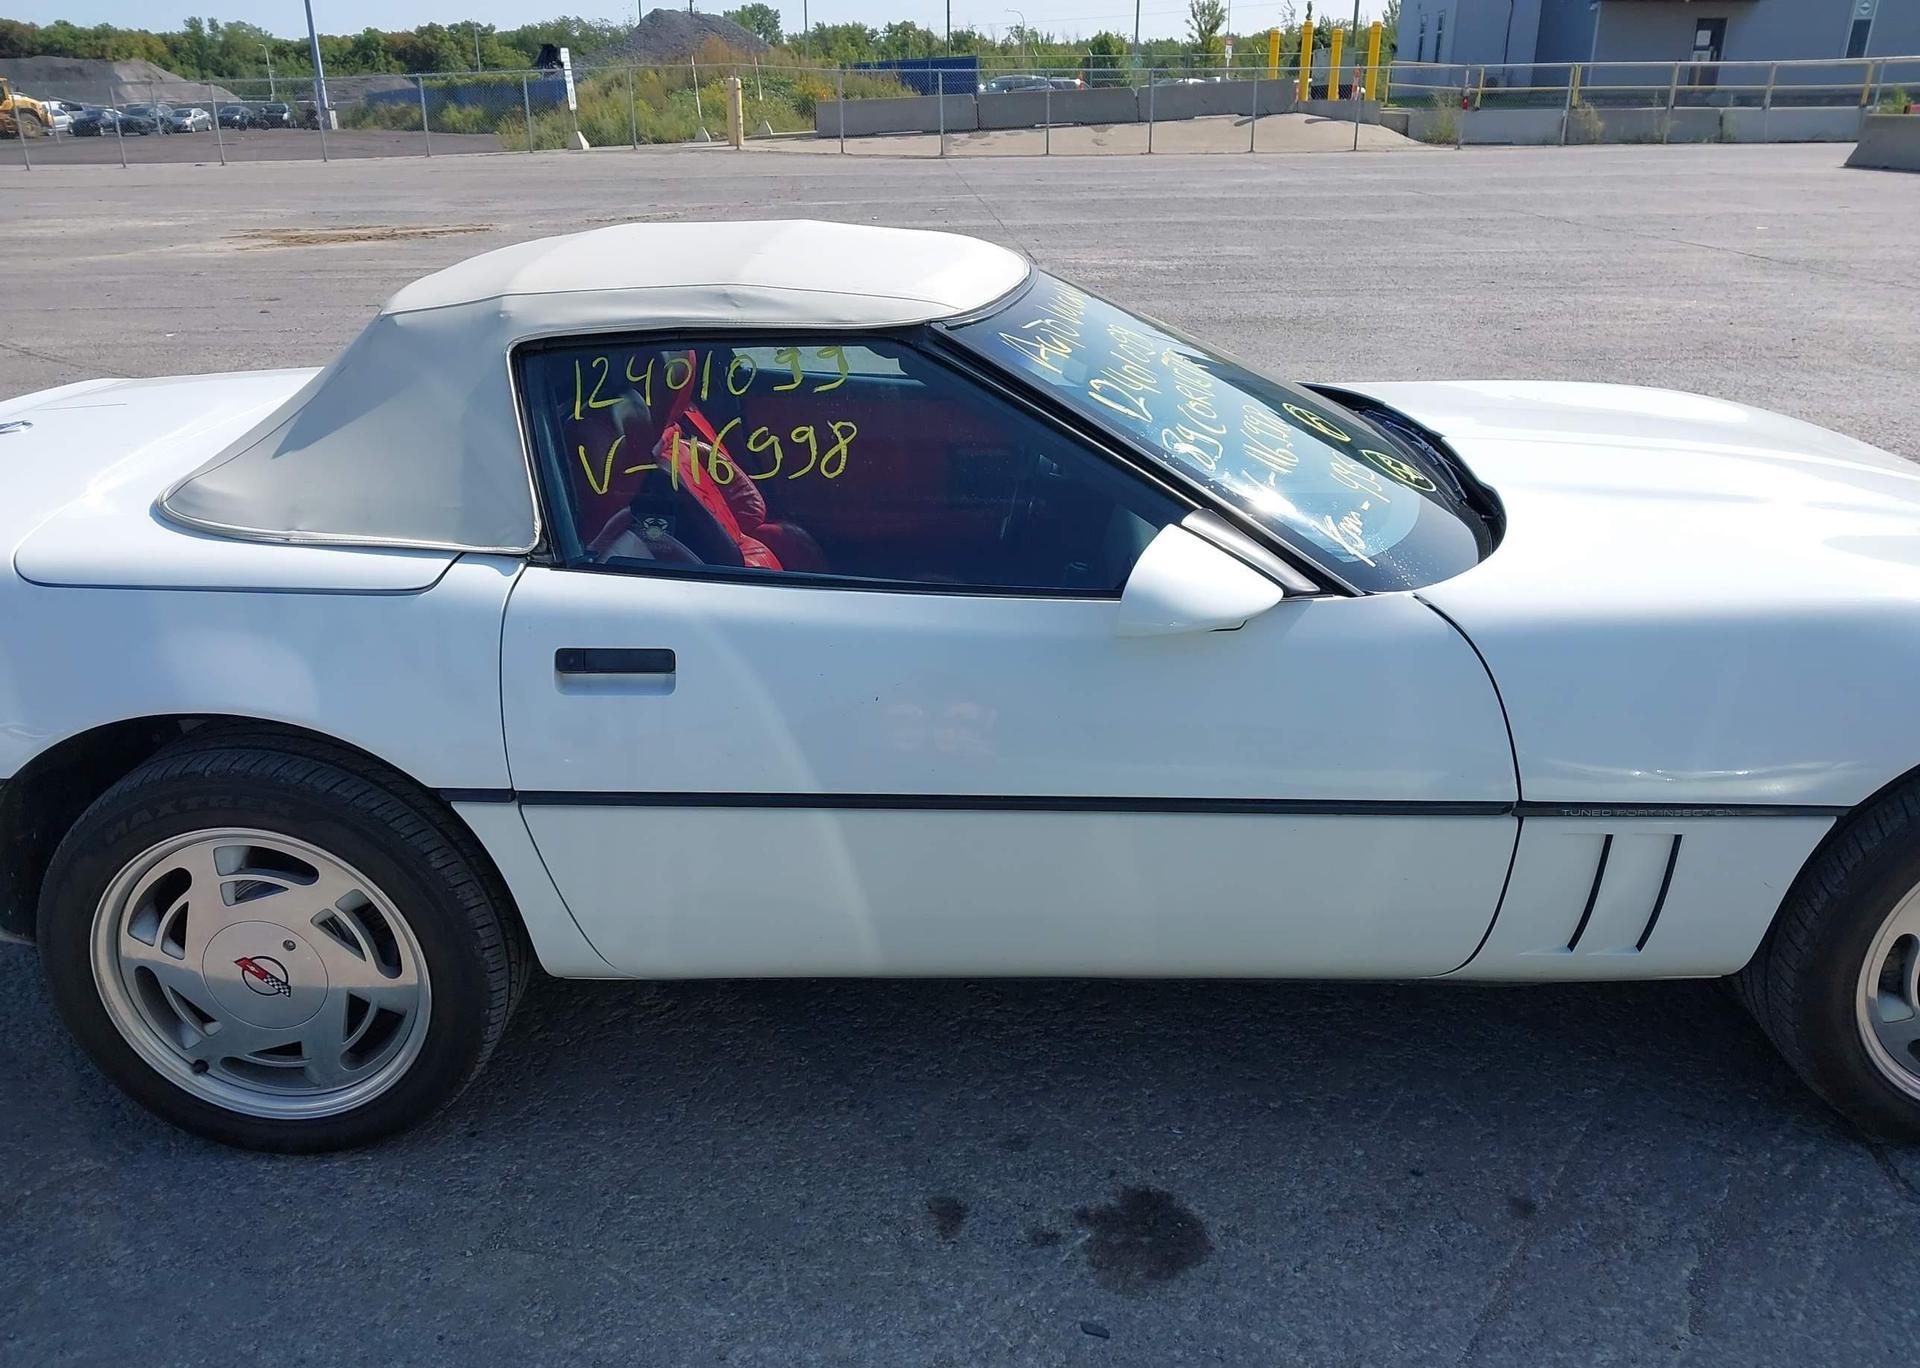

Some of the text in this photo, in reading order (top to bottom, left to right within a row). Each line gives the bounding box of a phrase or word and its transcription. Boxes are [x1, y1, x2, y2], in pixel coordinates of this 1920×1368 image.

[568, 346, 850, 421] 12401099
[578, 417, 858, 494] V-116998
[1562, 808, 1612, 817] TUNED
[1617, 808, 1656, 817] PORT
